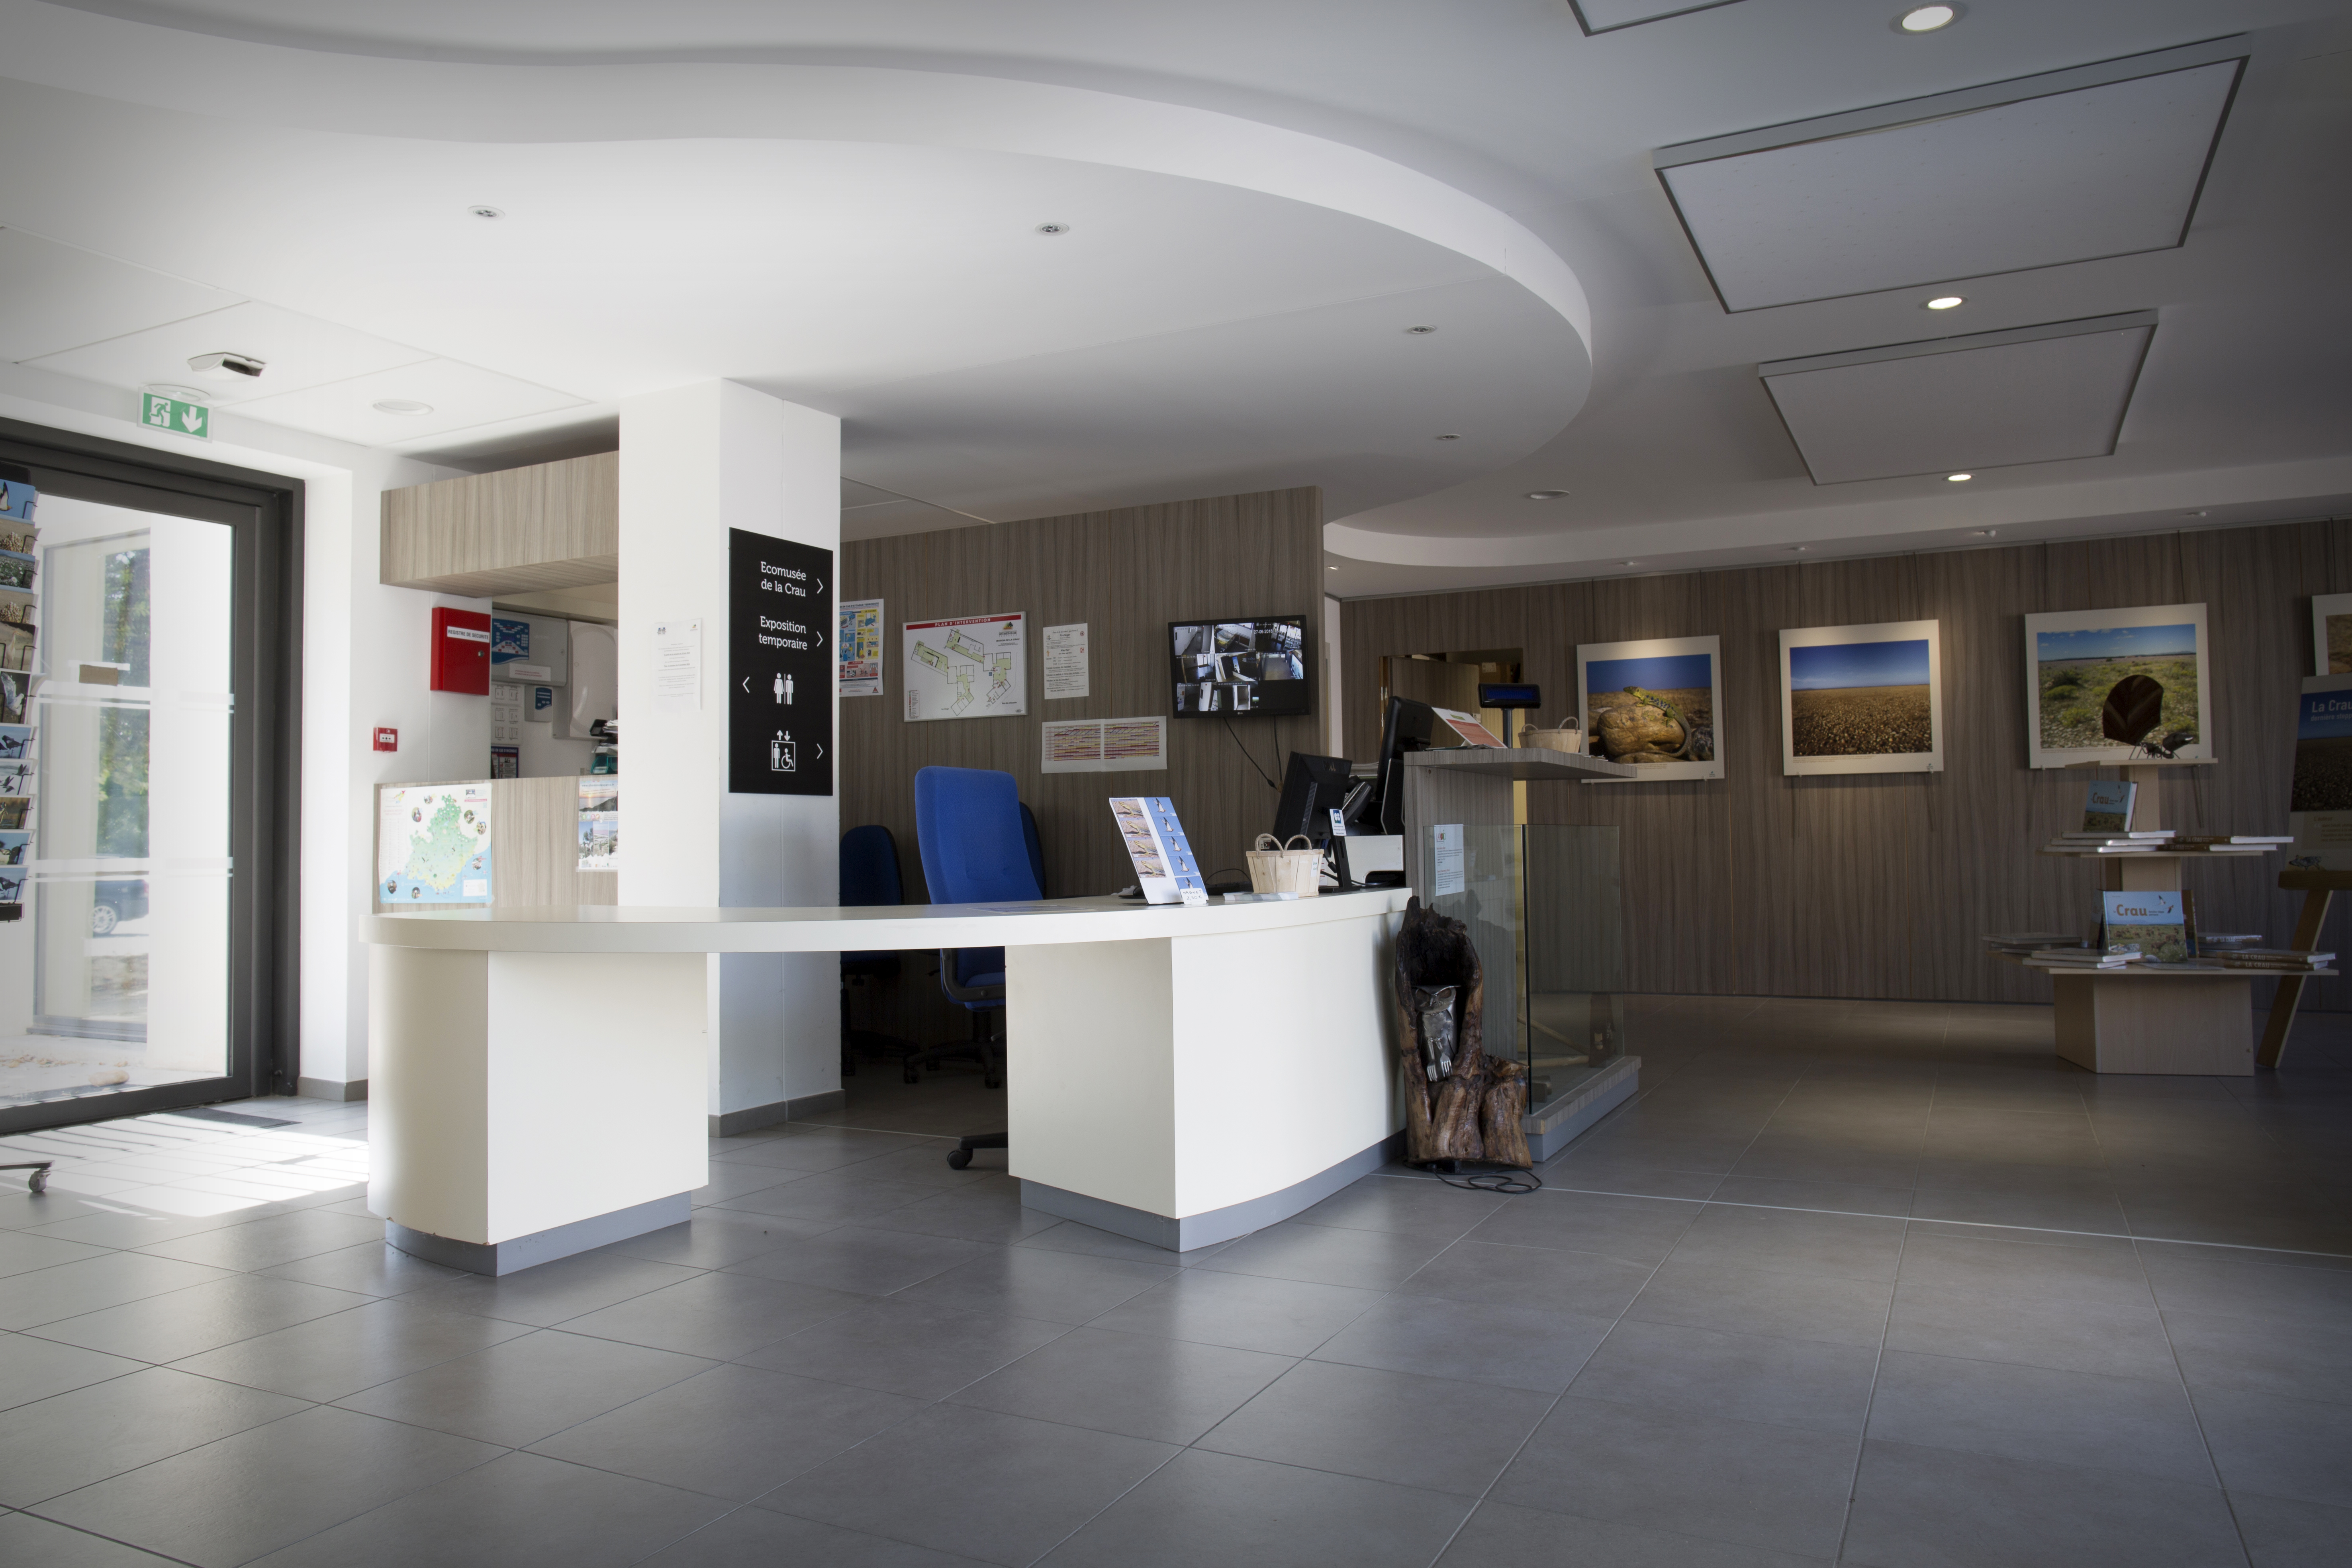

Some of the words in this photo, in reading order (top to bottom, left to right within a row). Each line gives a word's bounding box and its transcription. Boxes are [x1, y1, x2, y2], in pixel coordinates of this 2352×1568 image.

[761, 561, 806, 581] Ecomusée
[761, 579, 772, 590] de
[775, 581, 783, 592] la
[785, 583, 806, 597] Crau
[760, 616, 806, 634] Exposition
[759, 633, 807, 650] temporaire
[2312, 701, 2325, 713] La
[2329, 700, 2352, 711] Crau
[2092, 792, 2109, 805] Crau
[2117, 904, 2148, 916] Crau
